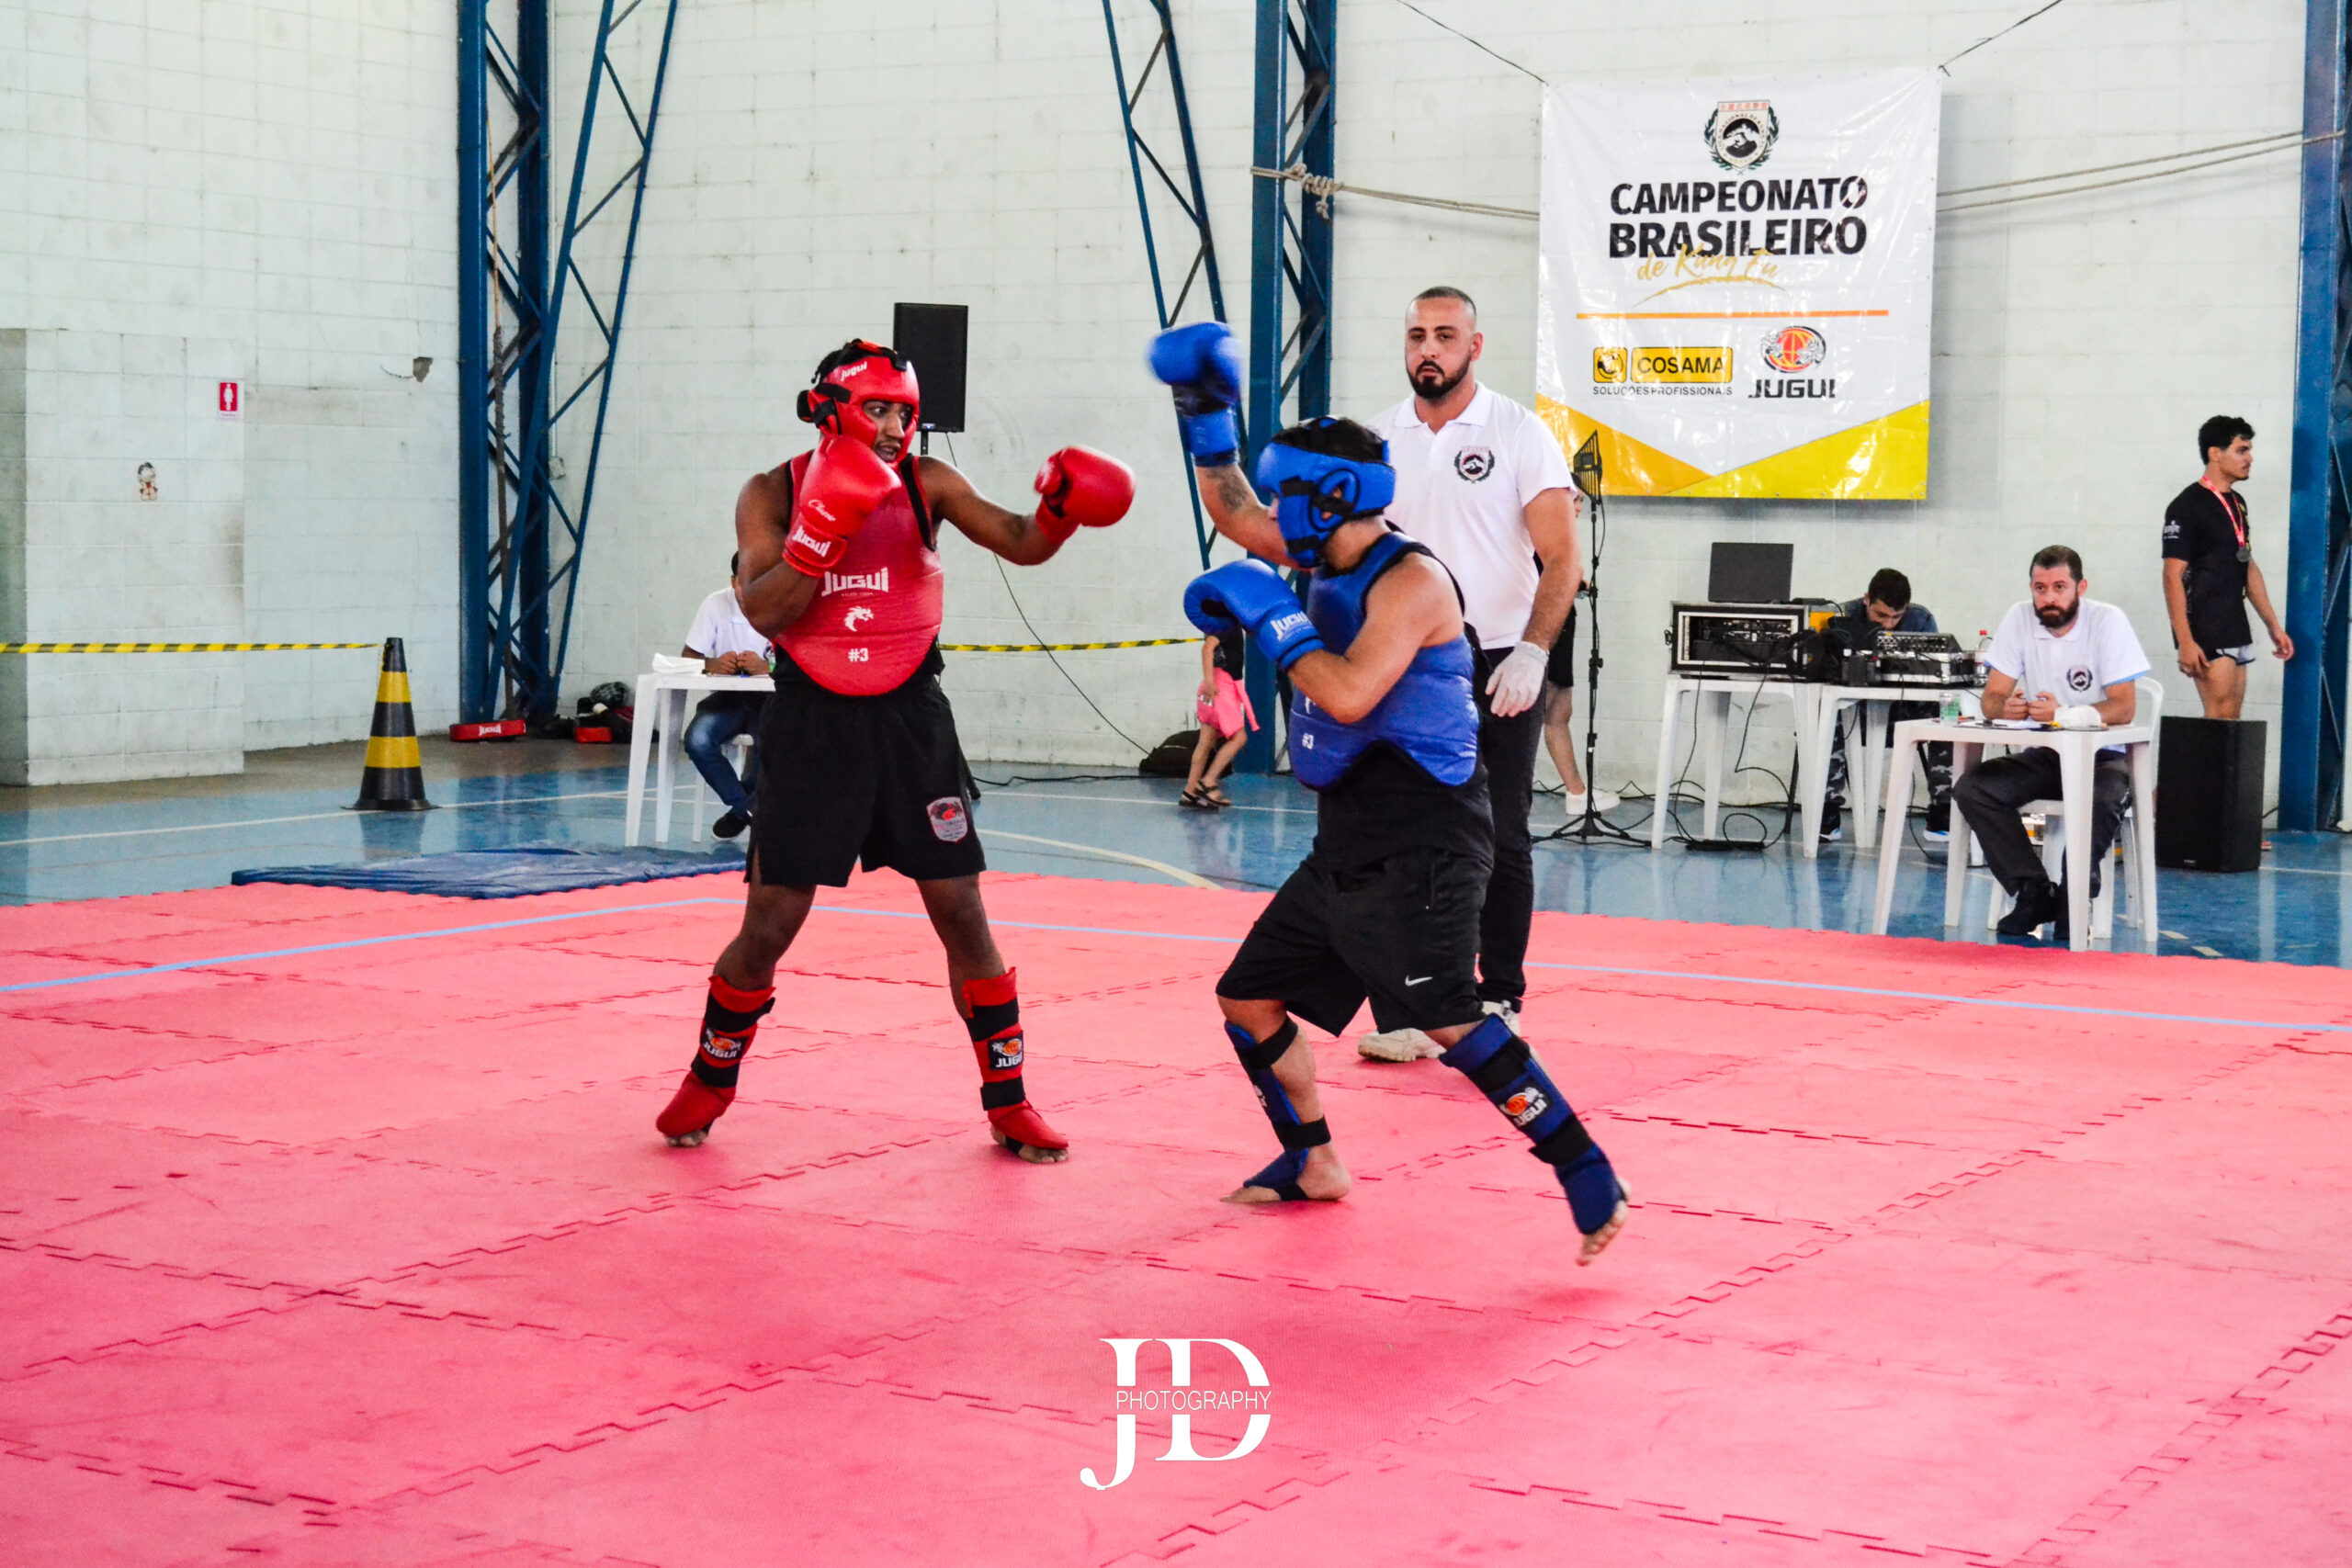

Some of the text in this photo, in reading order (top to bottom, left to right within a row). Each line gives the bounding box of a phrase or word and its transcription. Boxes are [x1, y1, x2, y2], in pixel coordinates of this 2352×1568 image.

[1611, 175, 1868, 215] CAMPEONATO
[1609, 216, 1867, 258] BRASILEIRO
[1637, 243, 1781, 280] de Kung Fu
[1637, 356, 1725, 374] COSAMA
[1651, 385, 1733, 397] PROFISSIONAS
[1748, 378, 1836, 399] JUGUI
[821, 567, 889, 597] JUGUI
[1270, 610, 1313, 641] JUGU
[848, 648, 869, 662] #3
[995, 1051, 1023, 1067] JUG
[1512, 1099, 1548, 1128] UGUI
